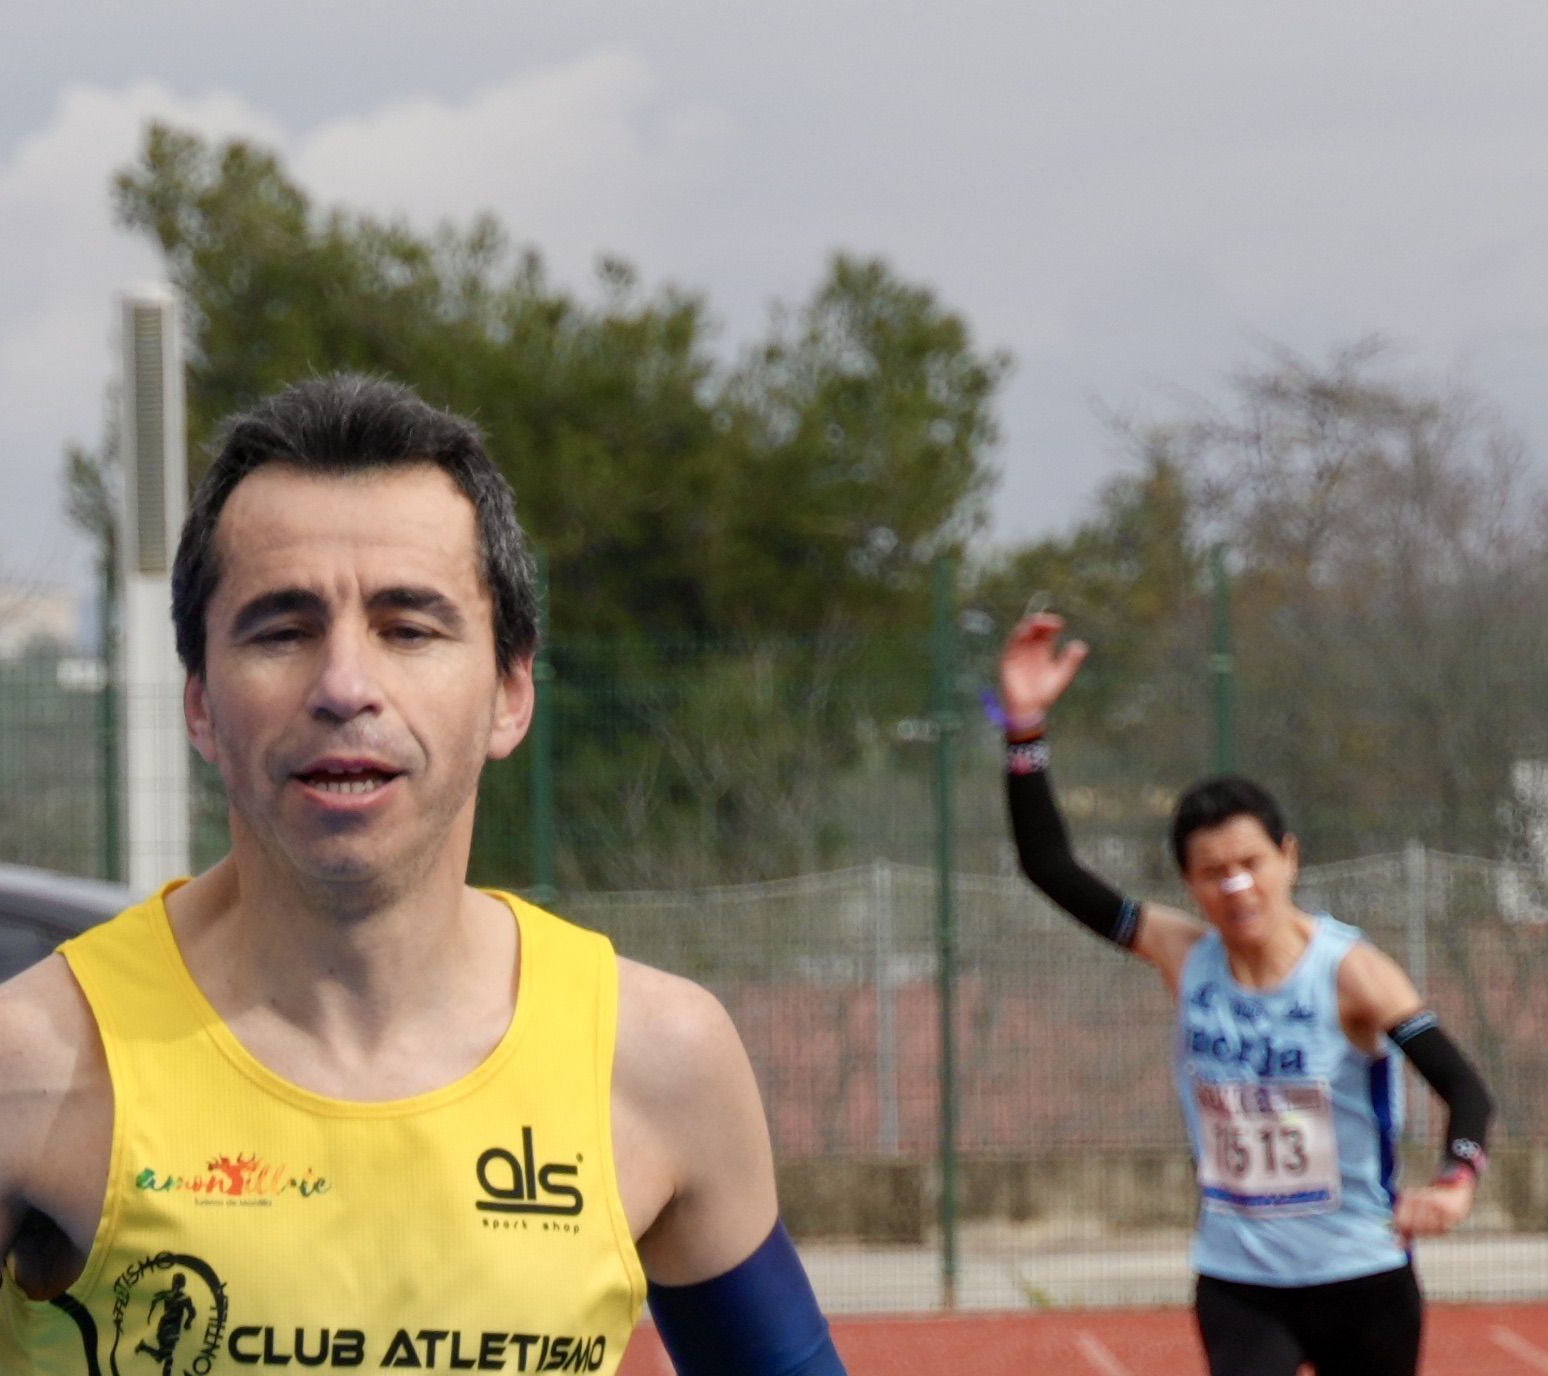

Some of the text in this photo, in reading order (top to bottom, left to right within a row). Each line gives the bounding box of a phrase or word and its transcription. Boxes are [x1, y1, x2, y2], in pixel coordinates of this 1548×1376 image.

[475, 1125, 584, 1217] als
[543, 1220, 580, 1235] shop
[227, 1326, 606, 1373] CLUB ATLETISMO
